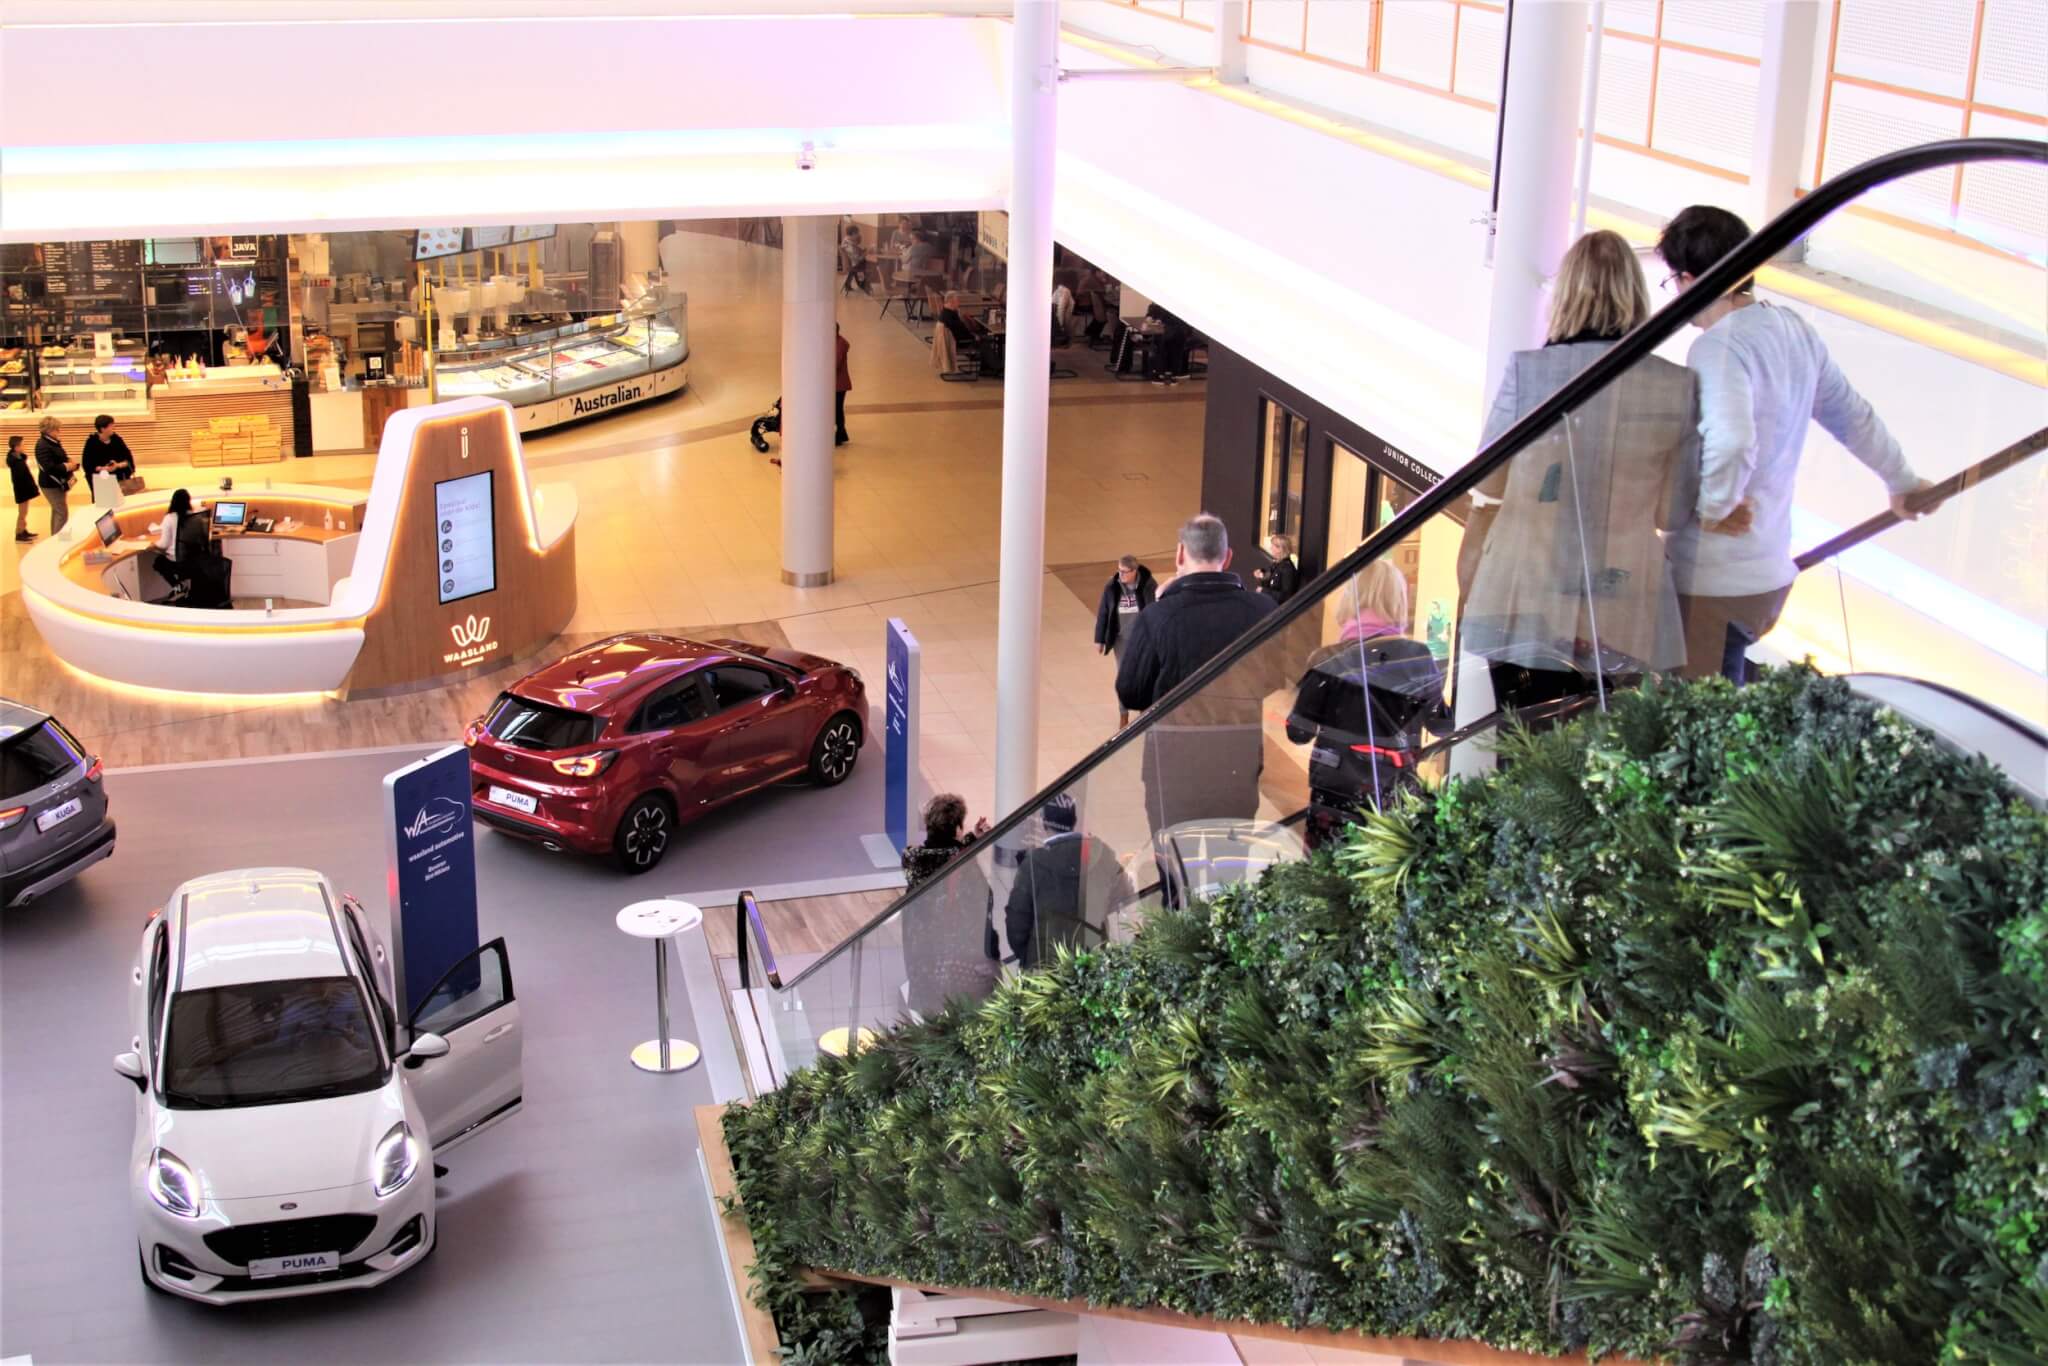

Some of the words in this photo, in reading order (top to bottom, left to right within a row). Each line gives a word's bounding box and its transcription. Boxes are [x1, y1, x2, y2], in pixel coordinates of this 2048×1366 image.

[233, 243, 257, 252] JAVA
[573, 385, 641, 416] Australian
[1383, 445, 1409, 468] JUNIOR
[443, 641, 498, 664] WAASLAND
[506, 793, 529, 807] PUMA
[55, 805, 77, 820] KUGA
[282, 1256, 327, 1270] PUMA
